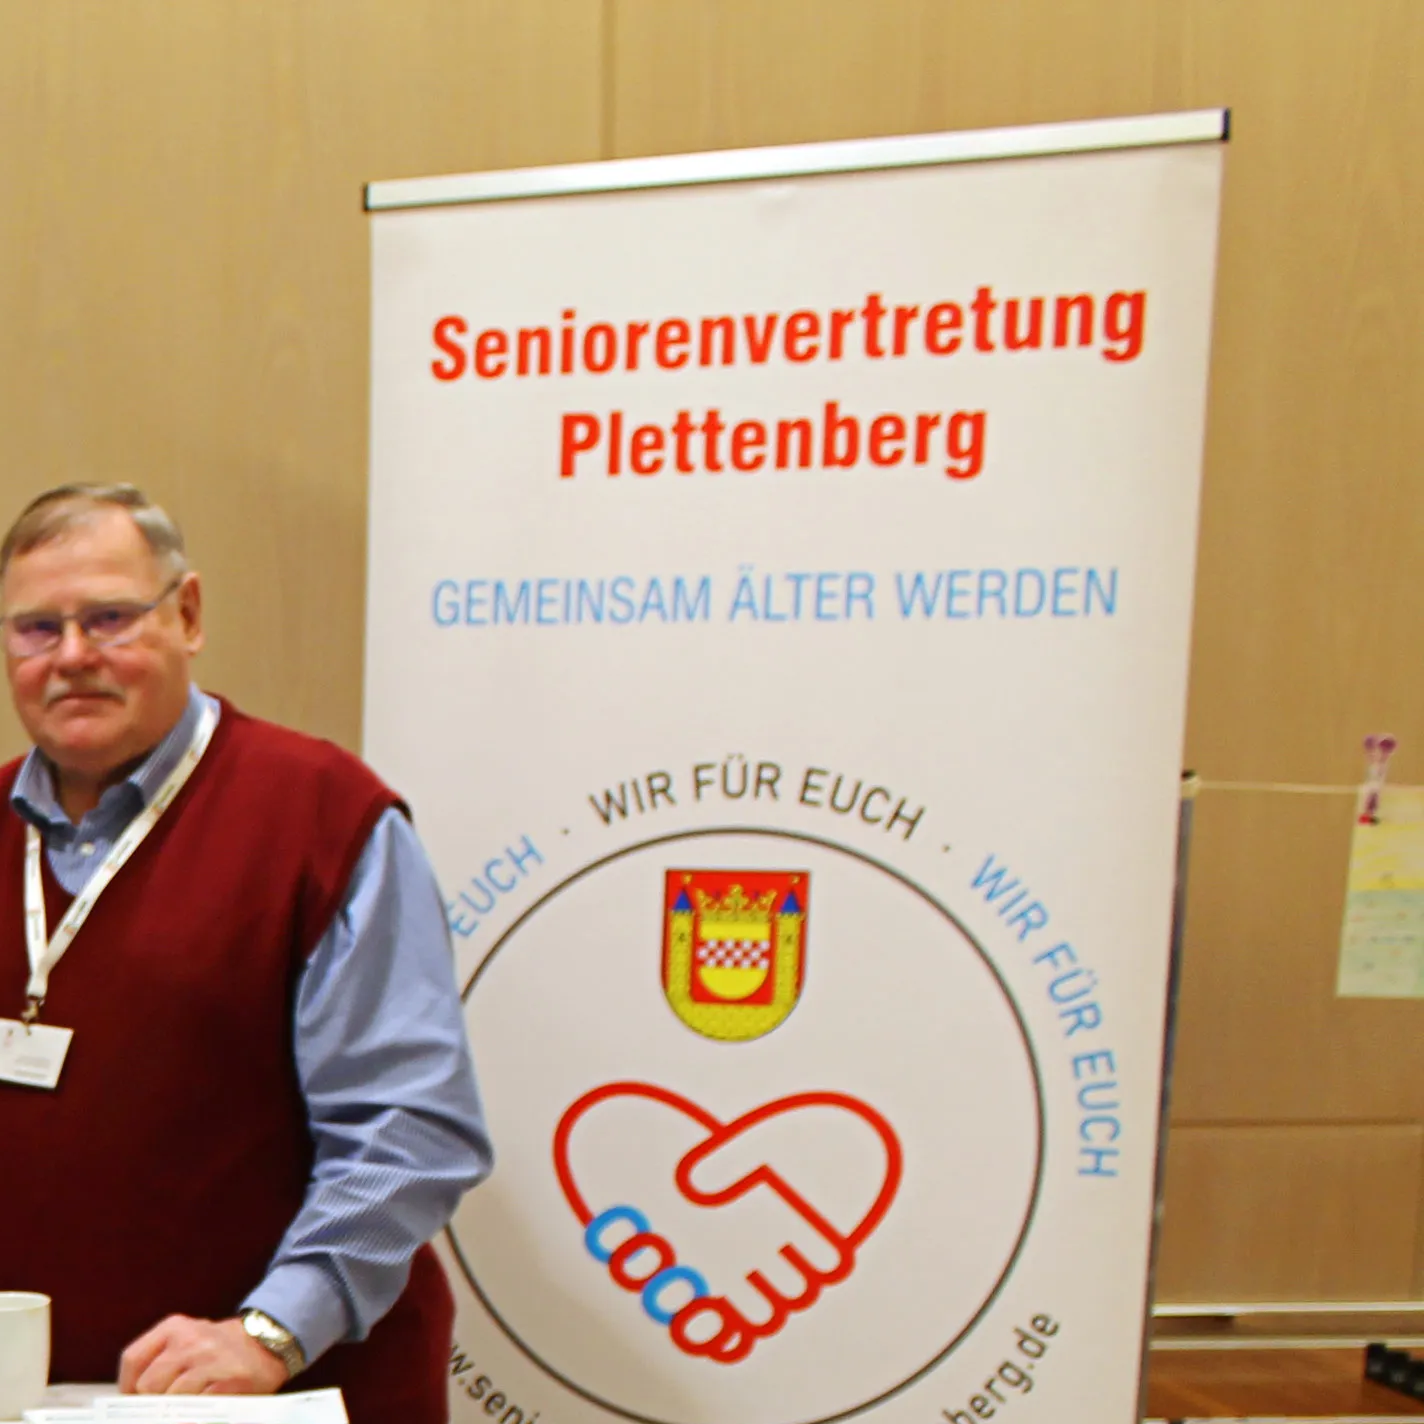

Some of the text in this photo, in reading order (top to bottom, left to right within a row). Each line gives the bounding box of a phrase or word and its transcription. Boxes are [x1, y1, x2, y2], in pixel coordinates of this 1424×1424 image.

[430, 285, 1147, 383] Seniorenvertretung
[558, 400, 986, 480] Plettenberg
[432, 564, 1119, 627] GEMEINSAM ÄLTER WERDEN
[588, 754, 925, 841] WIR FÜR EUCH
[449, 834, 544, 938] EUCH
[970, 852, 1122, 1178] WIR FÜR EUCH
